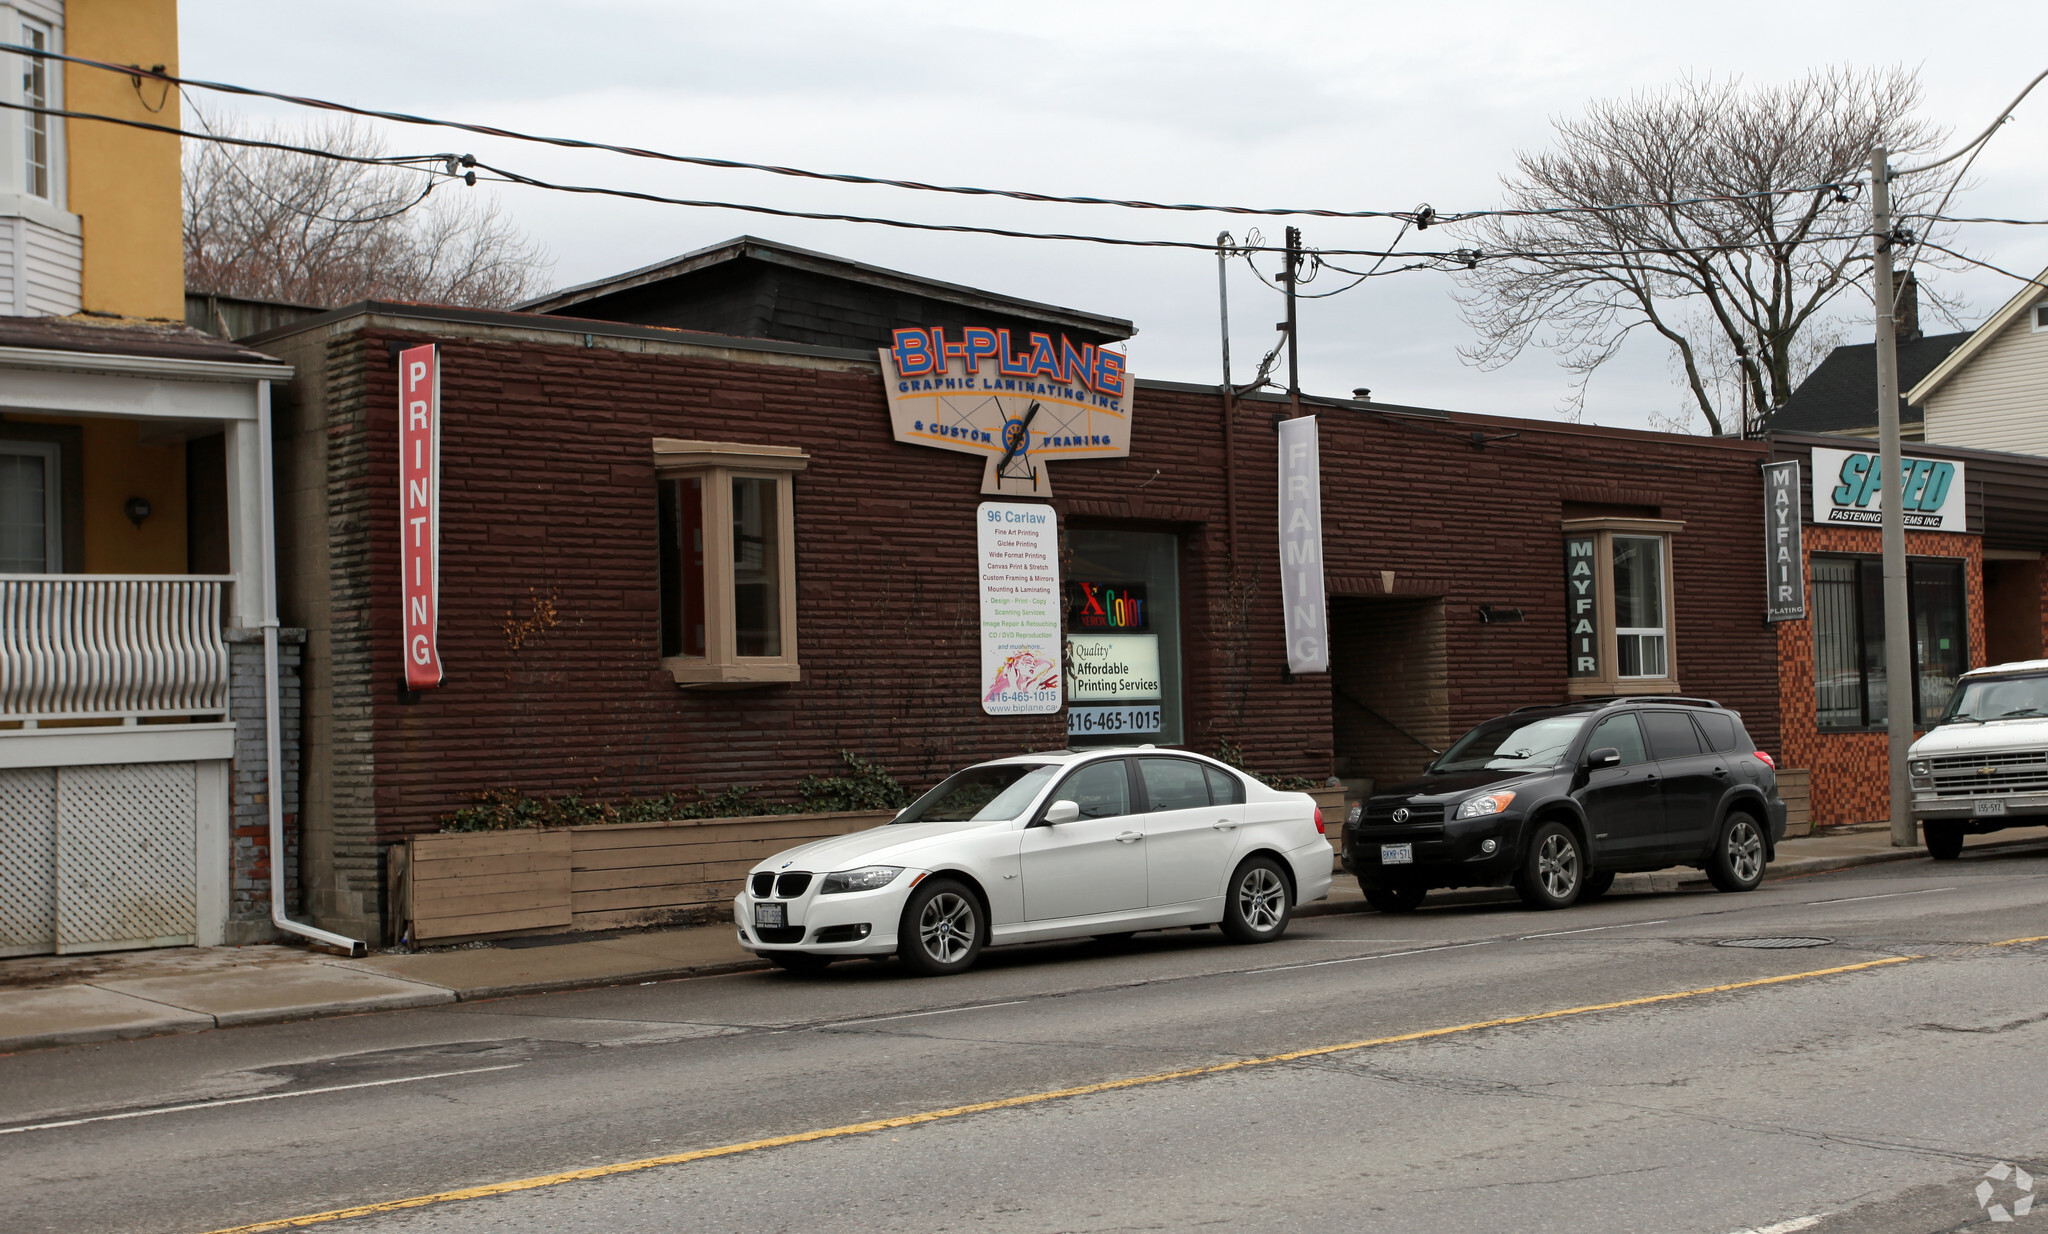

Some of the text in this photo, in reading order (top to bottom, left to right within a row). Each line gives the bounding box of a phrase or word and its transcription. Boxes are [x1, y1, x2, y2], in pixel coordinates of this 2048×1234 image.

[891, 326, 1126, 397] BI-PLANE
[898, 377, 1124, 413] GRAPHIC LAMINATING INC.
[929, 422, 991, 443] CUSTOM
[1043, 434, 1111, 447] FRAMING
[409, 361, 431, 665] PRINTING
[987, 510, 1046, 524] 96 Carlaw
[994, 528, 1007, 536] Fine
[1017, 529, 1040, 538] Printing
[1772, 468, 1793, 602] MAYFAIR
[1016, 541, 1038, 549] Printing
[989, 551, 1047, 561] Wide Format Printing
[1286, 441, 1320, 663] FRAMING
[987, 563, 1009, 571] Canvas
[1029, 564, 1049, 572] Stretch
[982, 574, 1005, 583] Custom
[1005, 575, 1029, 584] Framing
[987, 586, 1014, 595] Mounting
[1020, 587, 1051, 596] Laminating
[990, 598, 1010, 606] Design
[1032, 598, 1047, 606] Copy
[1105, 589, 1144, 627] Color
[1570, 541, 1596, 673] MAYFAIR
[994, 609, 1021, 617] Scanning
[1770, 607, 1803, 615] PLATING
[983, 621, 1001, 629] Image
[1001, 621, 1020, 629] Repair
[1026, 621, 1057, 629] Retouching
[1077, 662, 1129, 675] Affordable
[1078, 678, 1158, 694] Printing Services
[989, 691, 1057, 702] 416-465-1015
[989, 704, 1057, 713] www.biplane.ca
[1068, 711, 1160, 732] 416-465-1015
